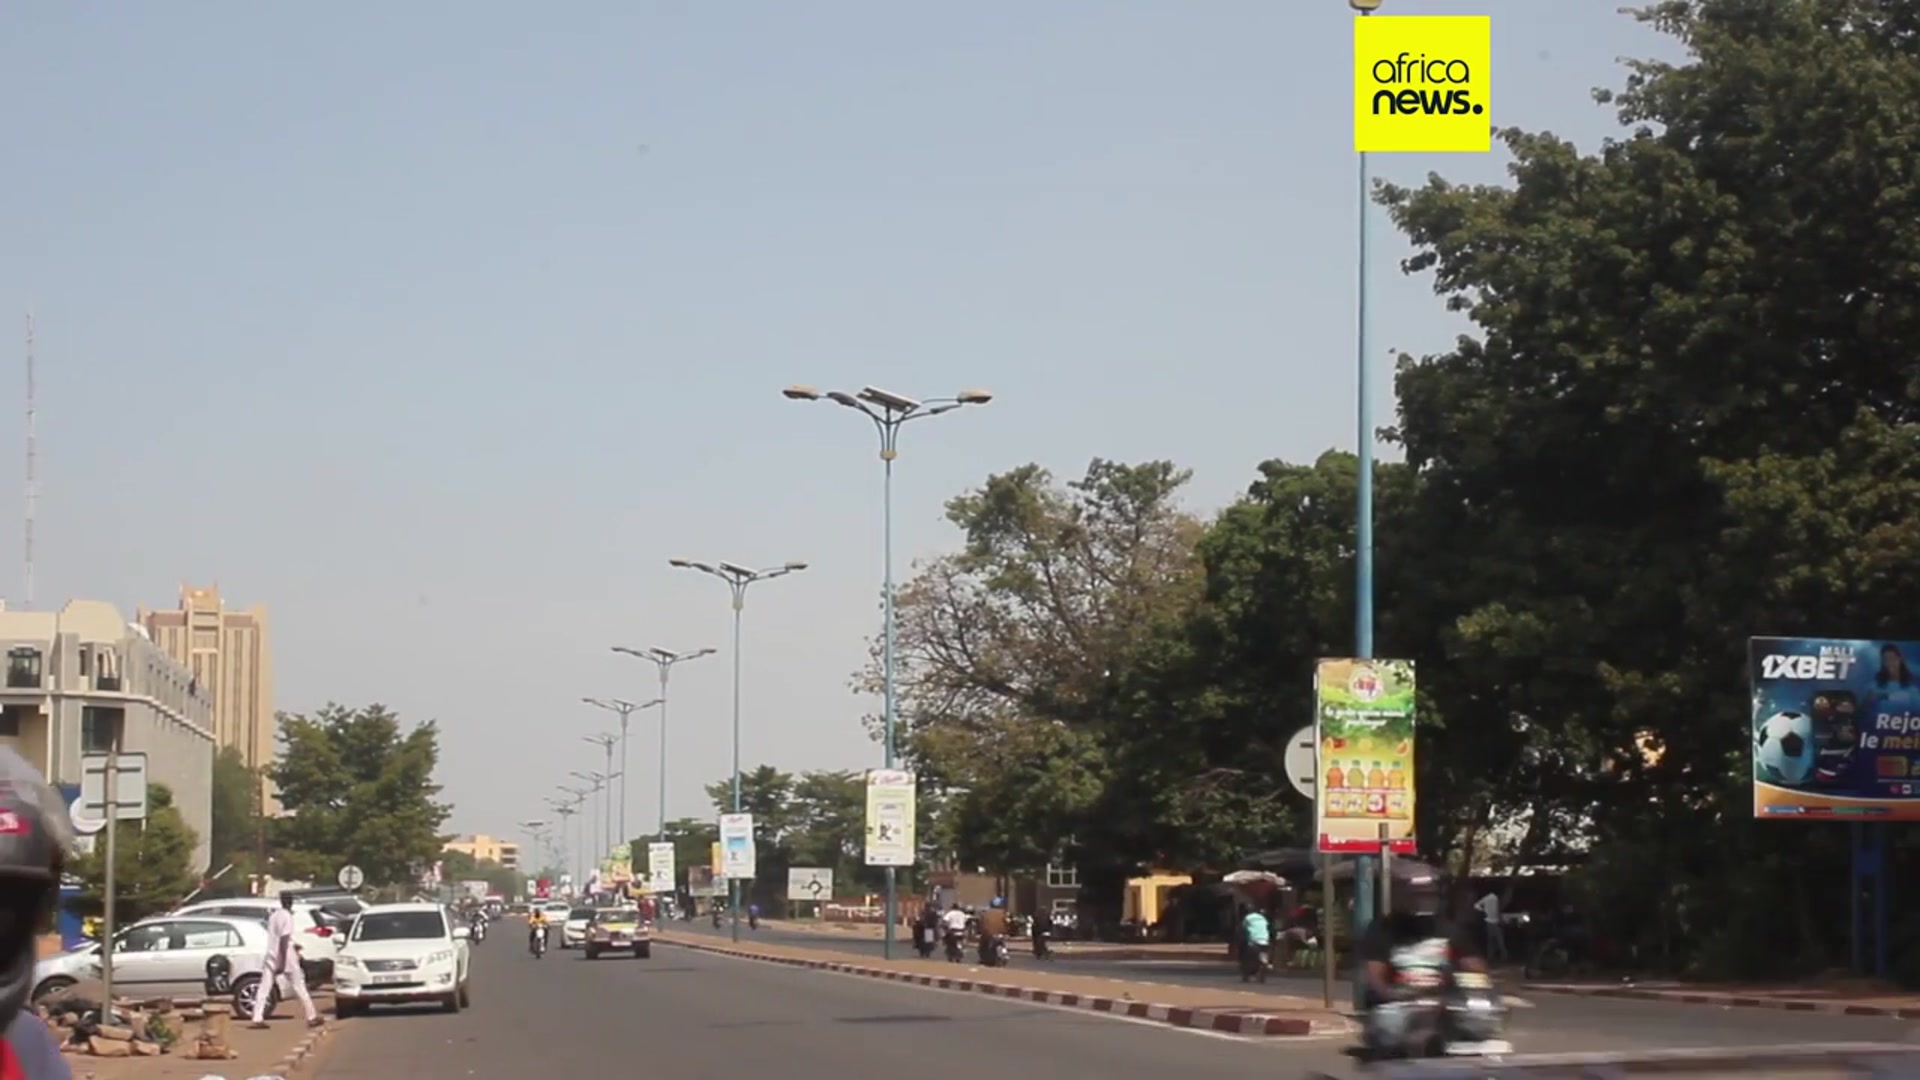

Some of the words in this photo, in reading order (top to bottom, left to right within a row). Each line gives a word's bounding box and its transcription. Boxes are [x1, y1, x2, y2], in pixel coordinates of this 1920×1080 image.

[1820, 646, 1854, 656] MALI
[1761, 654, 1856, 680] 1XBET
[1860, 732, 1879, 748] le
